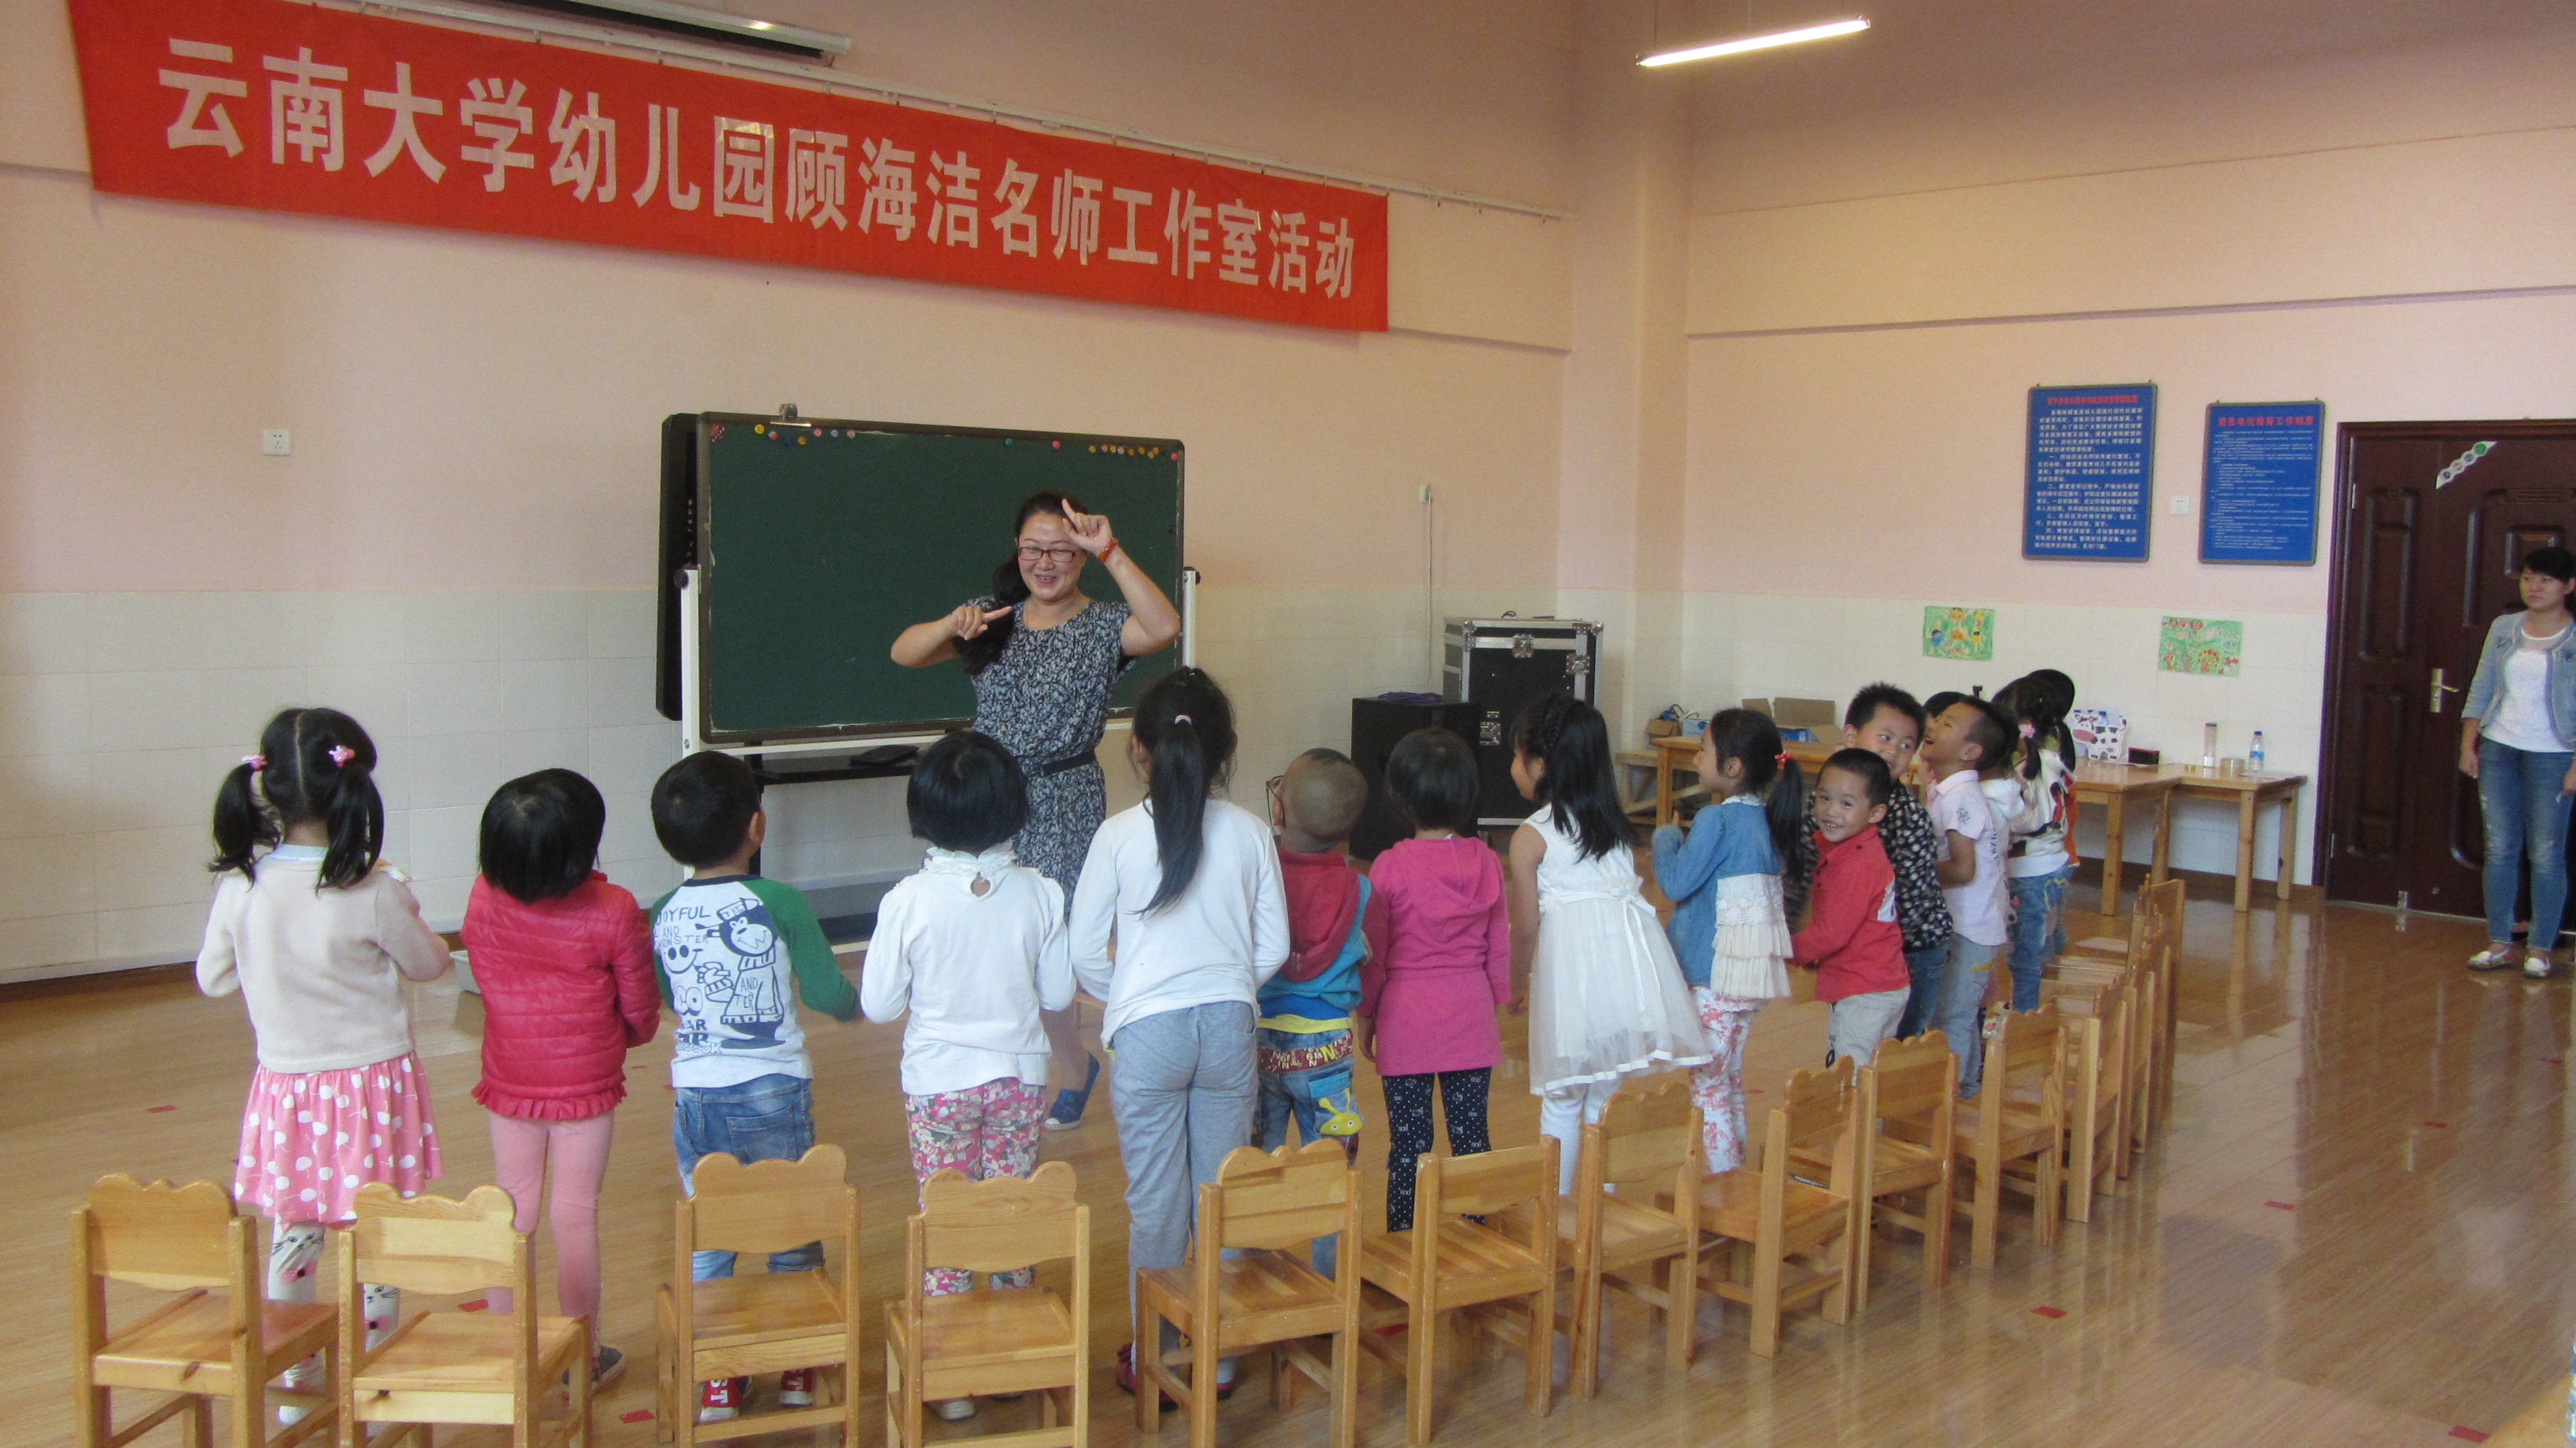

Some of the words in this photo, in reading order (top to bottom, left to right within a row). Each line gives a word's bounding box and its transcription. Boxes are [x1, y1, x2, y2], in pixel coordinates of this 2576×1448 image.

[158, 37, 1355, 300] 云南大学幼儿园顾海洁名师工作室活动
[656, 905, 711, 926] JOYFUL
